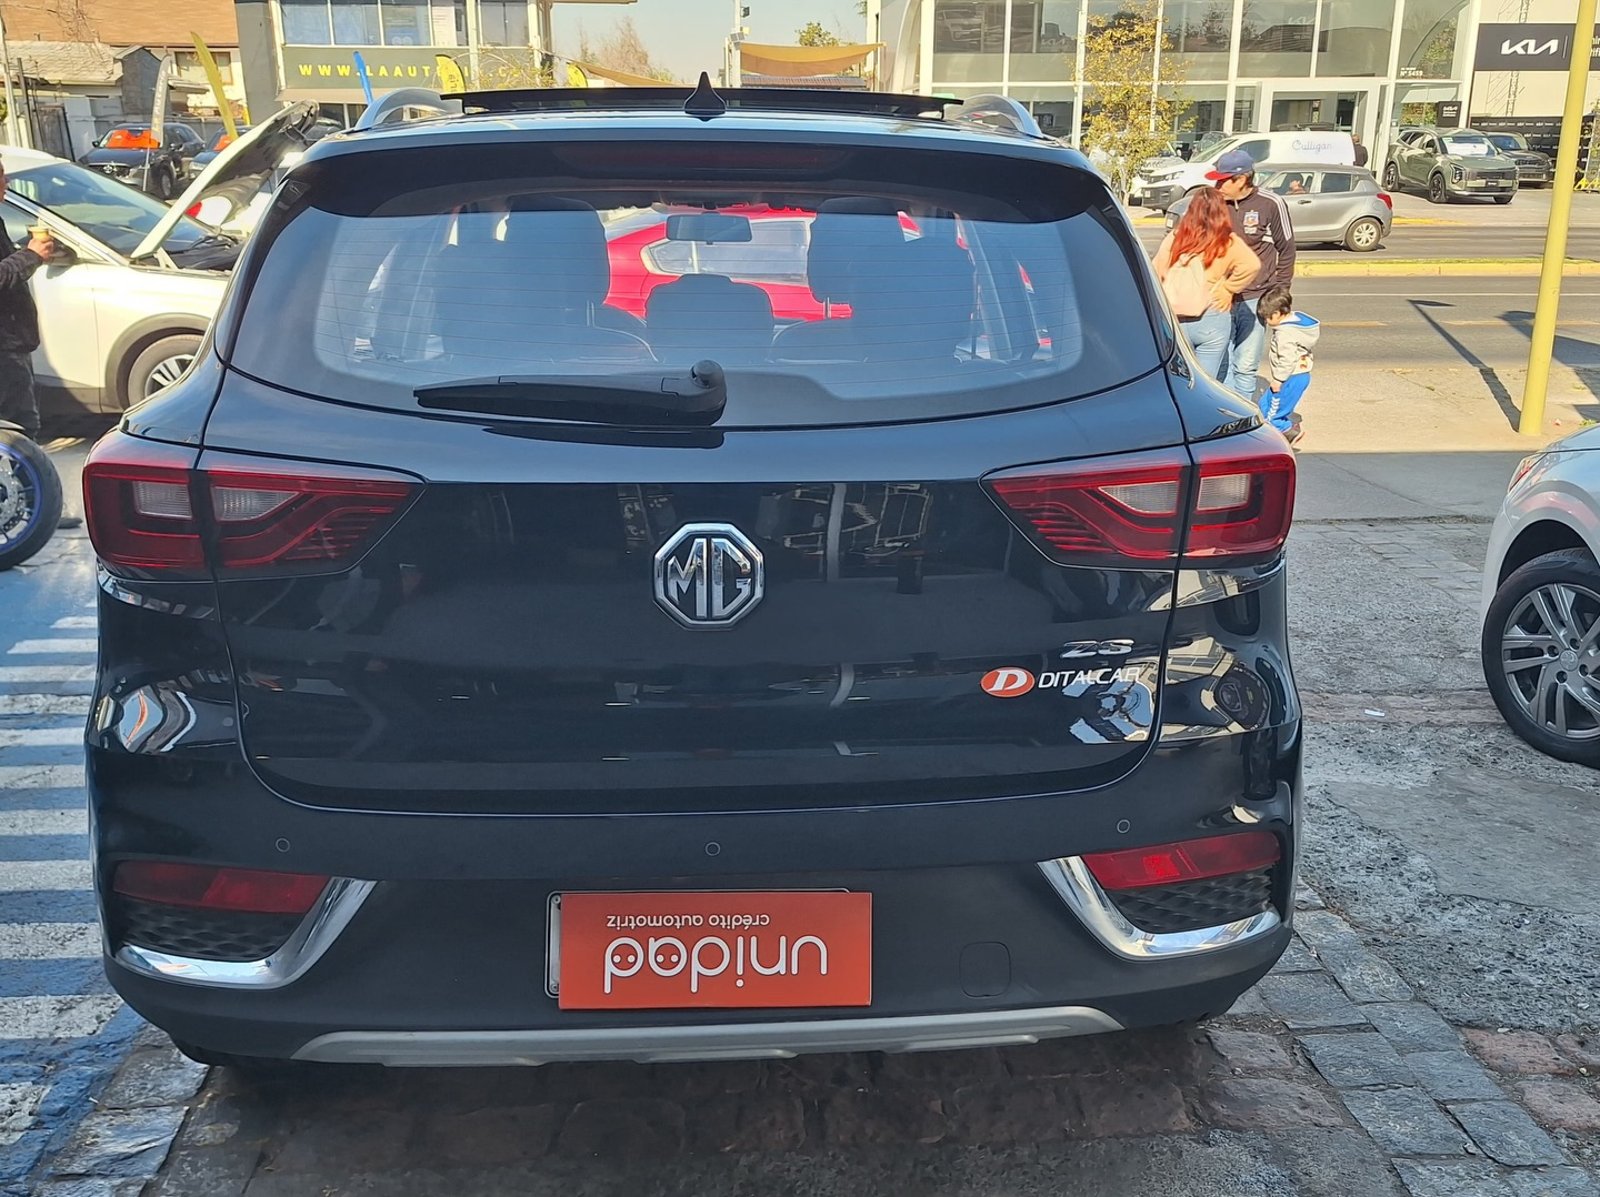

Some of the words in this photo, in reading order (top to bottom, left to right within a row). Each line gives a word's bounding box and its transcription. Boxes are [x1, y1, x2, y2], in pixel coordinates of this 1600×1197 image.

[1500, 39, 1559, 55] KIA
[667, 538, 752, 619] MG
[1060, 639, 1135, 659] ZS
[1038, 667, 1141, 689] DITALCAR
[606, 914, 704, 931] automotriz
[708, 914, 771, 930] crédito
[602, 935, 829, 995] unidad
